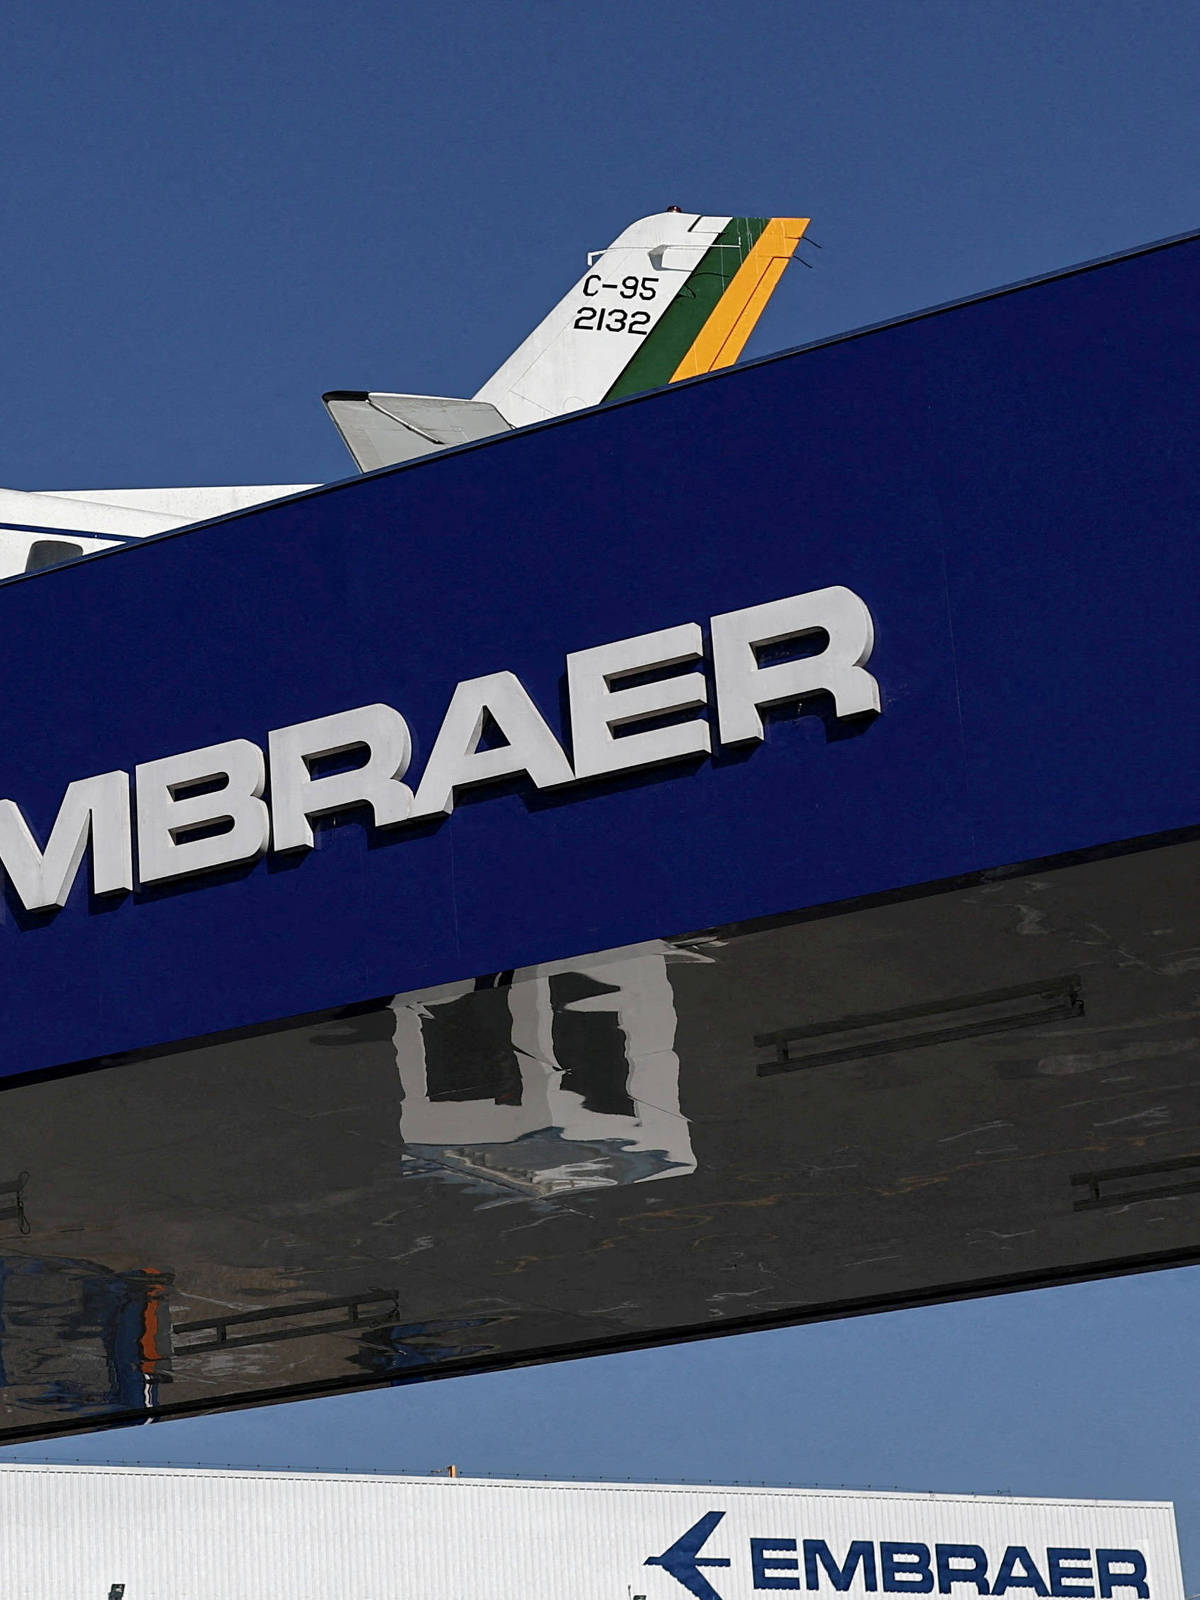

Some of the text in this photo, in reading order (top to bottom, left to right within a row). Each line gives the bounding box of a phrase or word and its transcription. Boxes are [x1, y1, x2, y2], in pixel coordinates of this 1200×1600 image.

[583, 274, 659, 300] C-95
[573, 306, 651, 335] 2132
[750, 1537, 1150, 1599] EMBRAER
